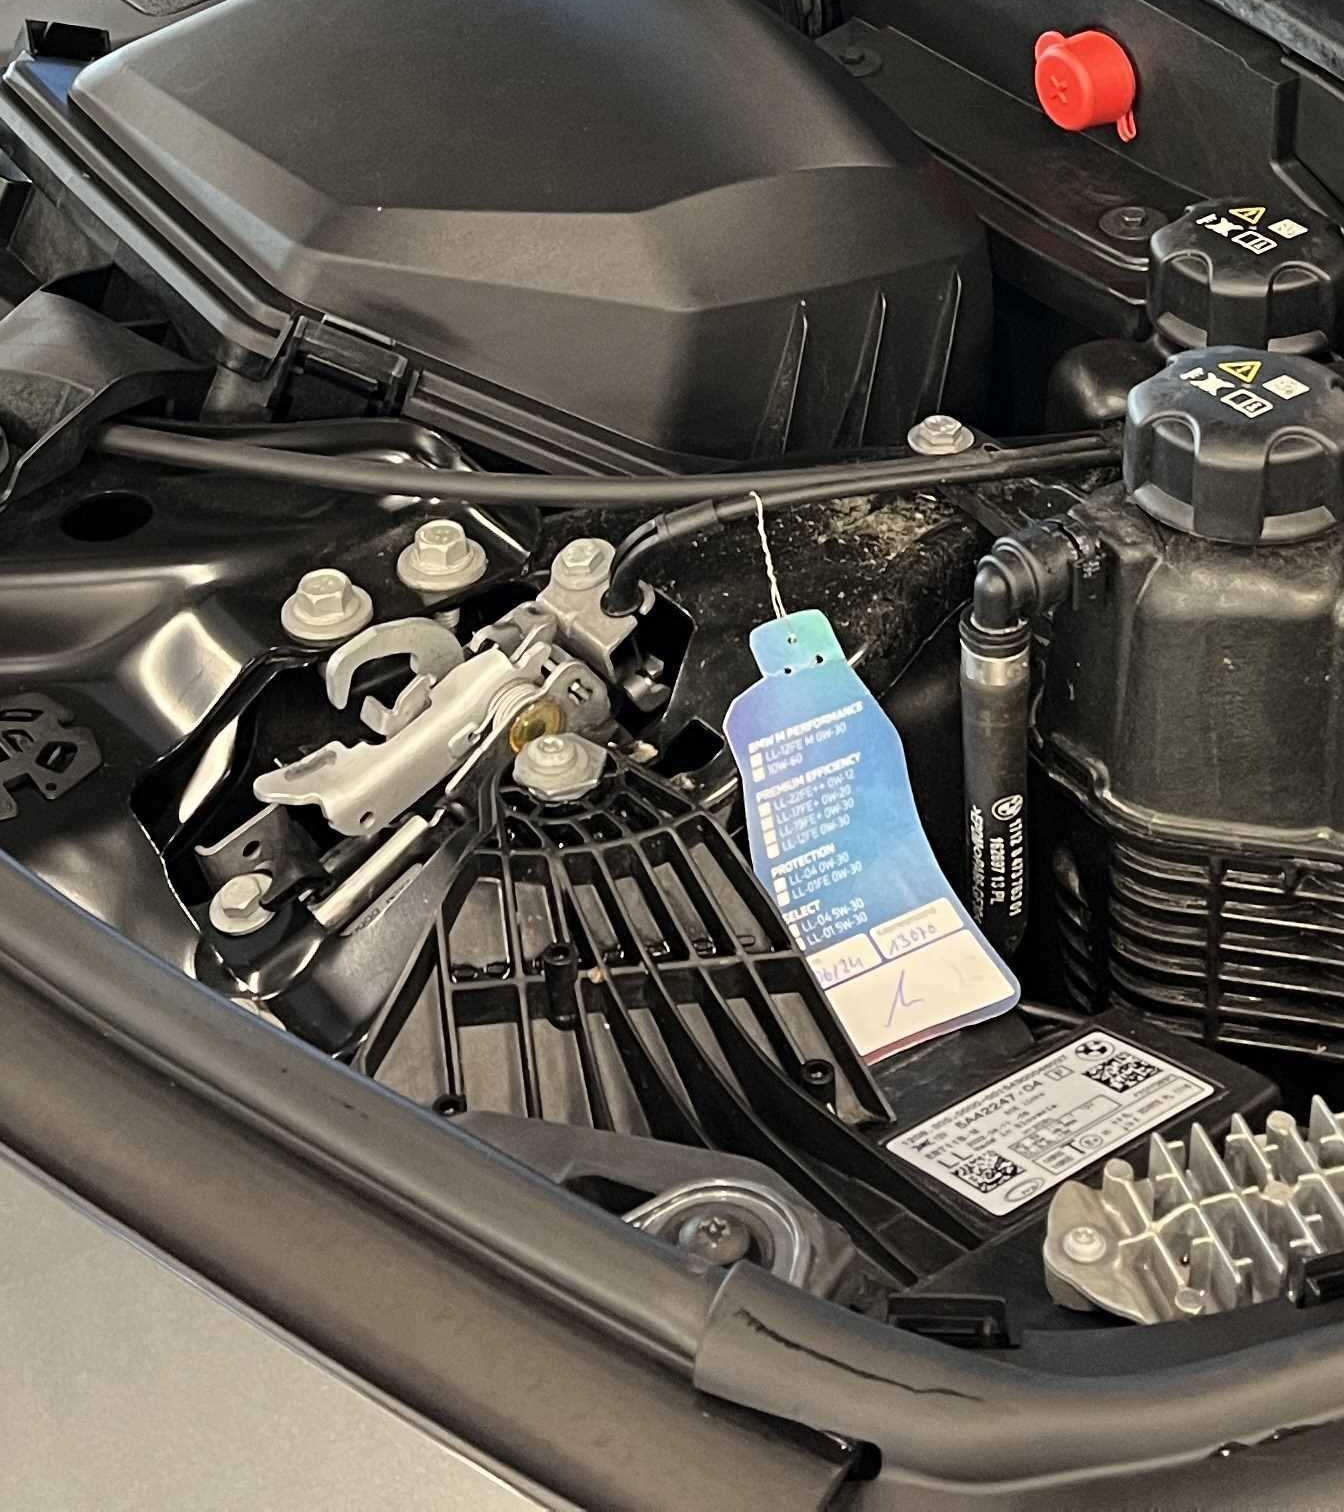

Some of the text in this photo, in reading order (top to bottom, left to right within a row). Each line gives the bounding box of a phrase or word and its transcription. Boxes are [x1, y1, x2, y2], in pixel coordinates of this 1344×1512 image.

[786, 700, 863, 738] PERFORMANCE
[756, 751, 861, 802] PREMIUM EFFICIENCY
[771, 842, 835, 878] PROTECTION
[782, 899, 820, 924] SELECT
[801, 896, 863, 933] LL-04 5W-30
[835, 910, 867, 933] 5W-30
